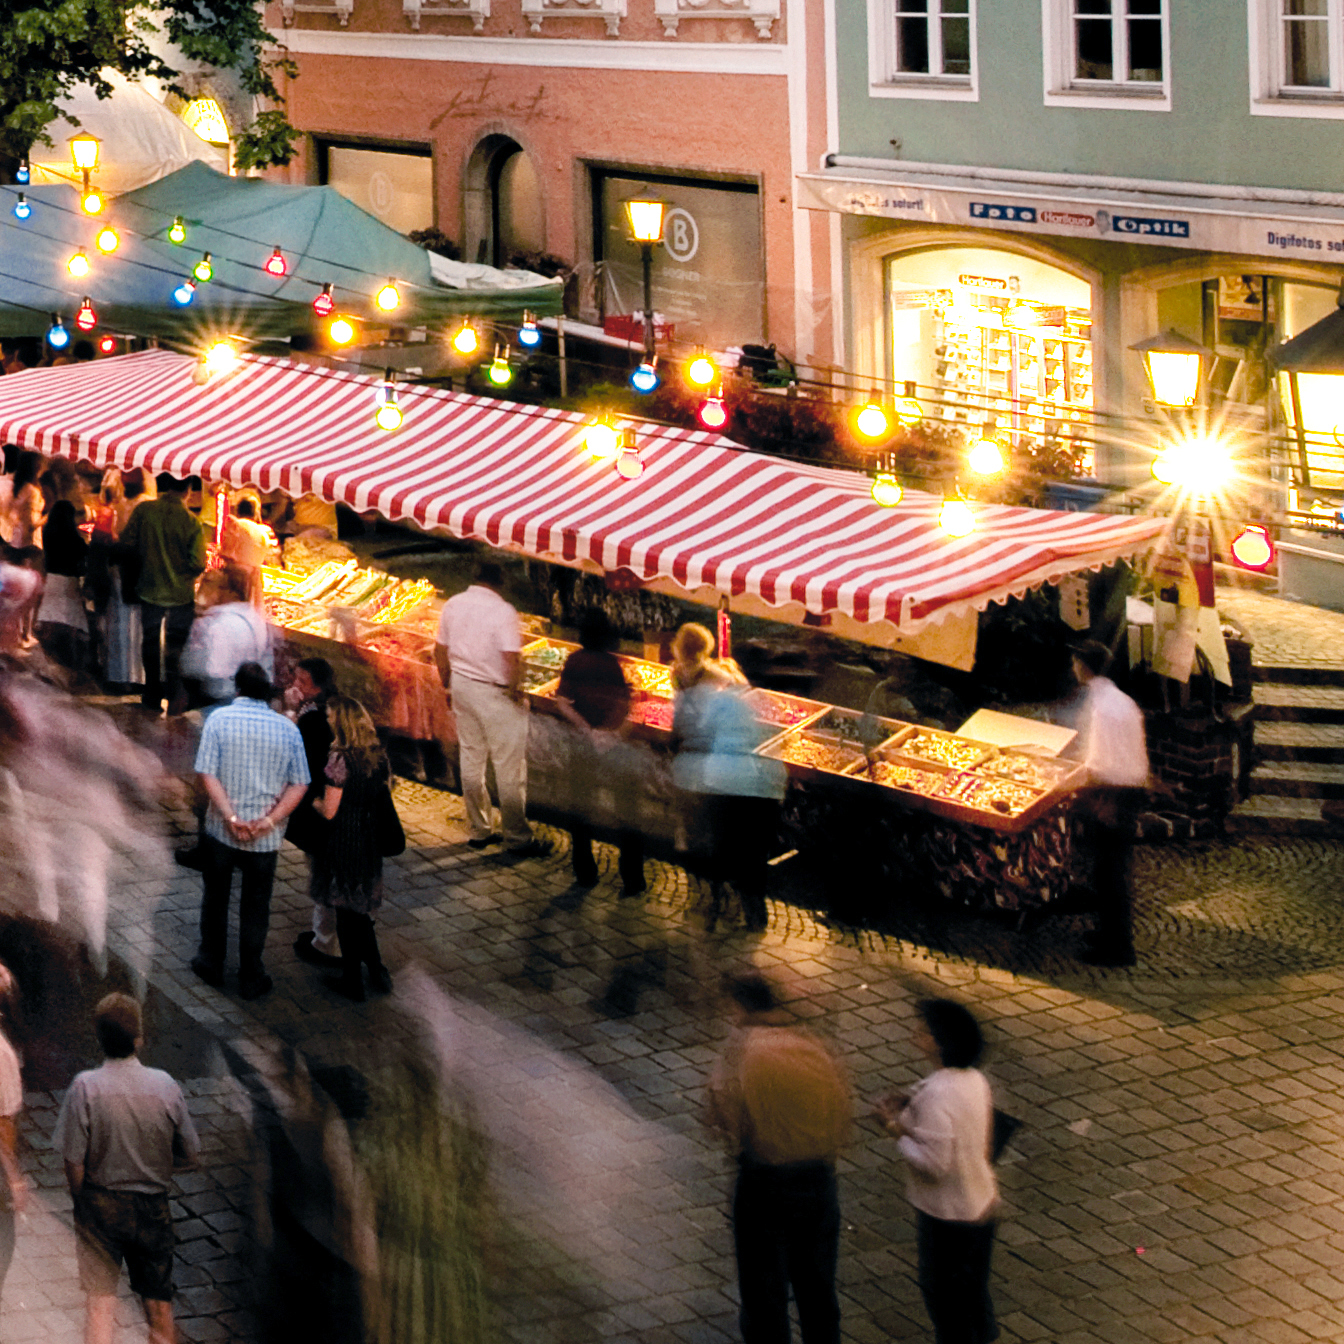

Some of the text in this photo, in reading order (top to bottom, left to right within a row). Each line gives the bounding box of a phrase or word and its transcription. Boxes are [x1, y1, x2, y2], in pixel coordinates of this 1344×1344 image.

[673, 219, 689, 251] B
[972, 205, 1186, 236] Foto Hartlauer Optik
[1267, 231, 1322, 250] Digifotos
